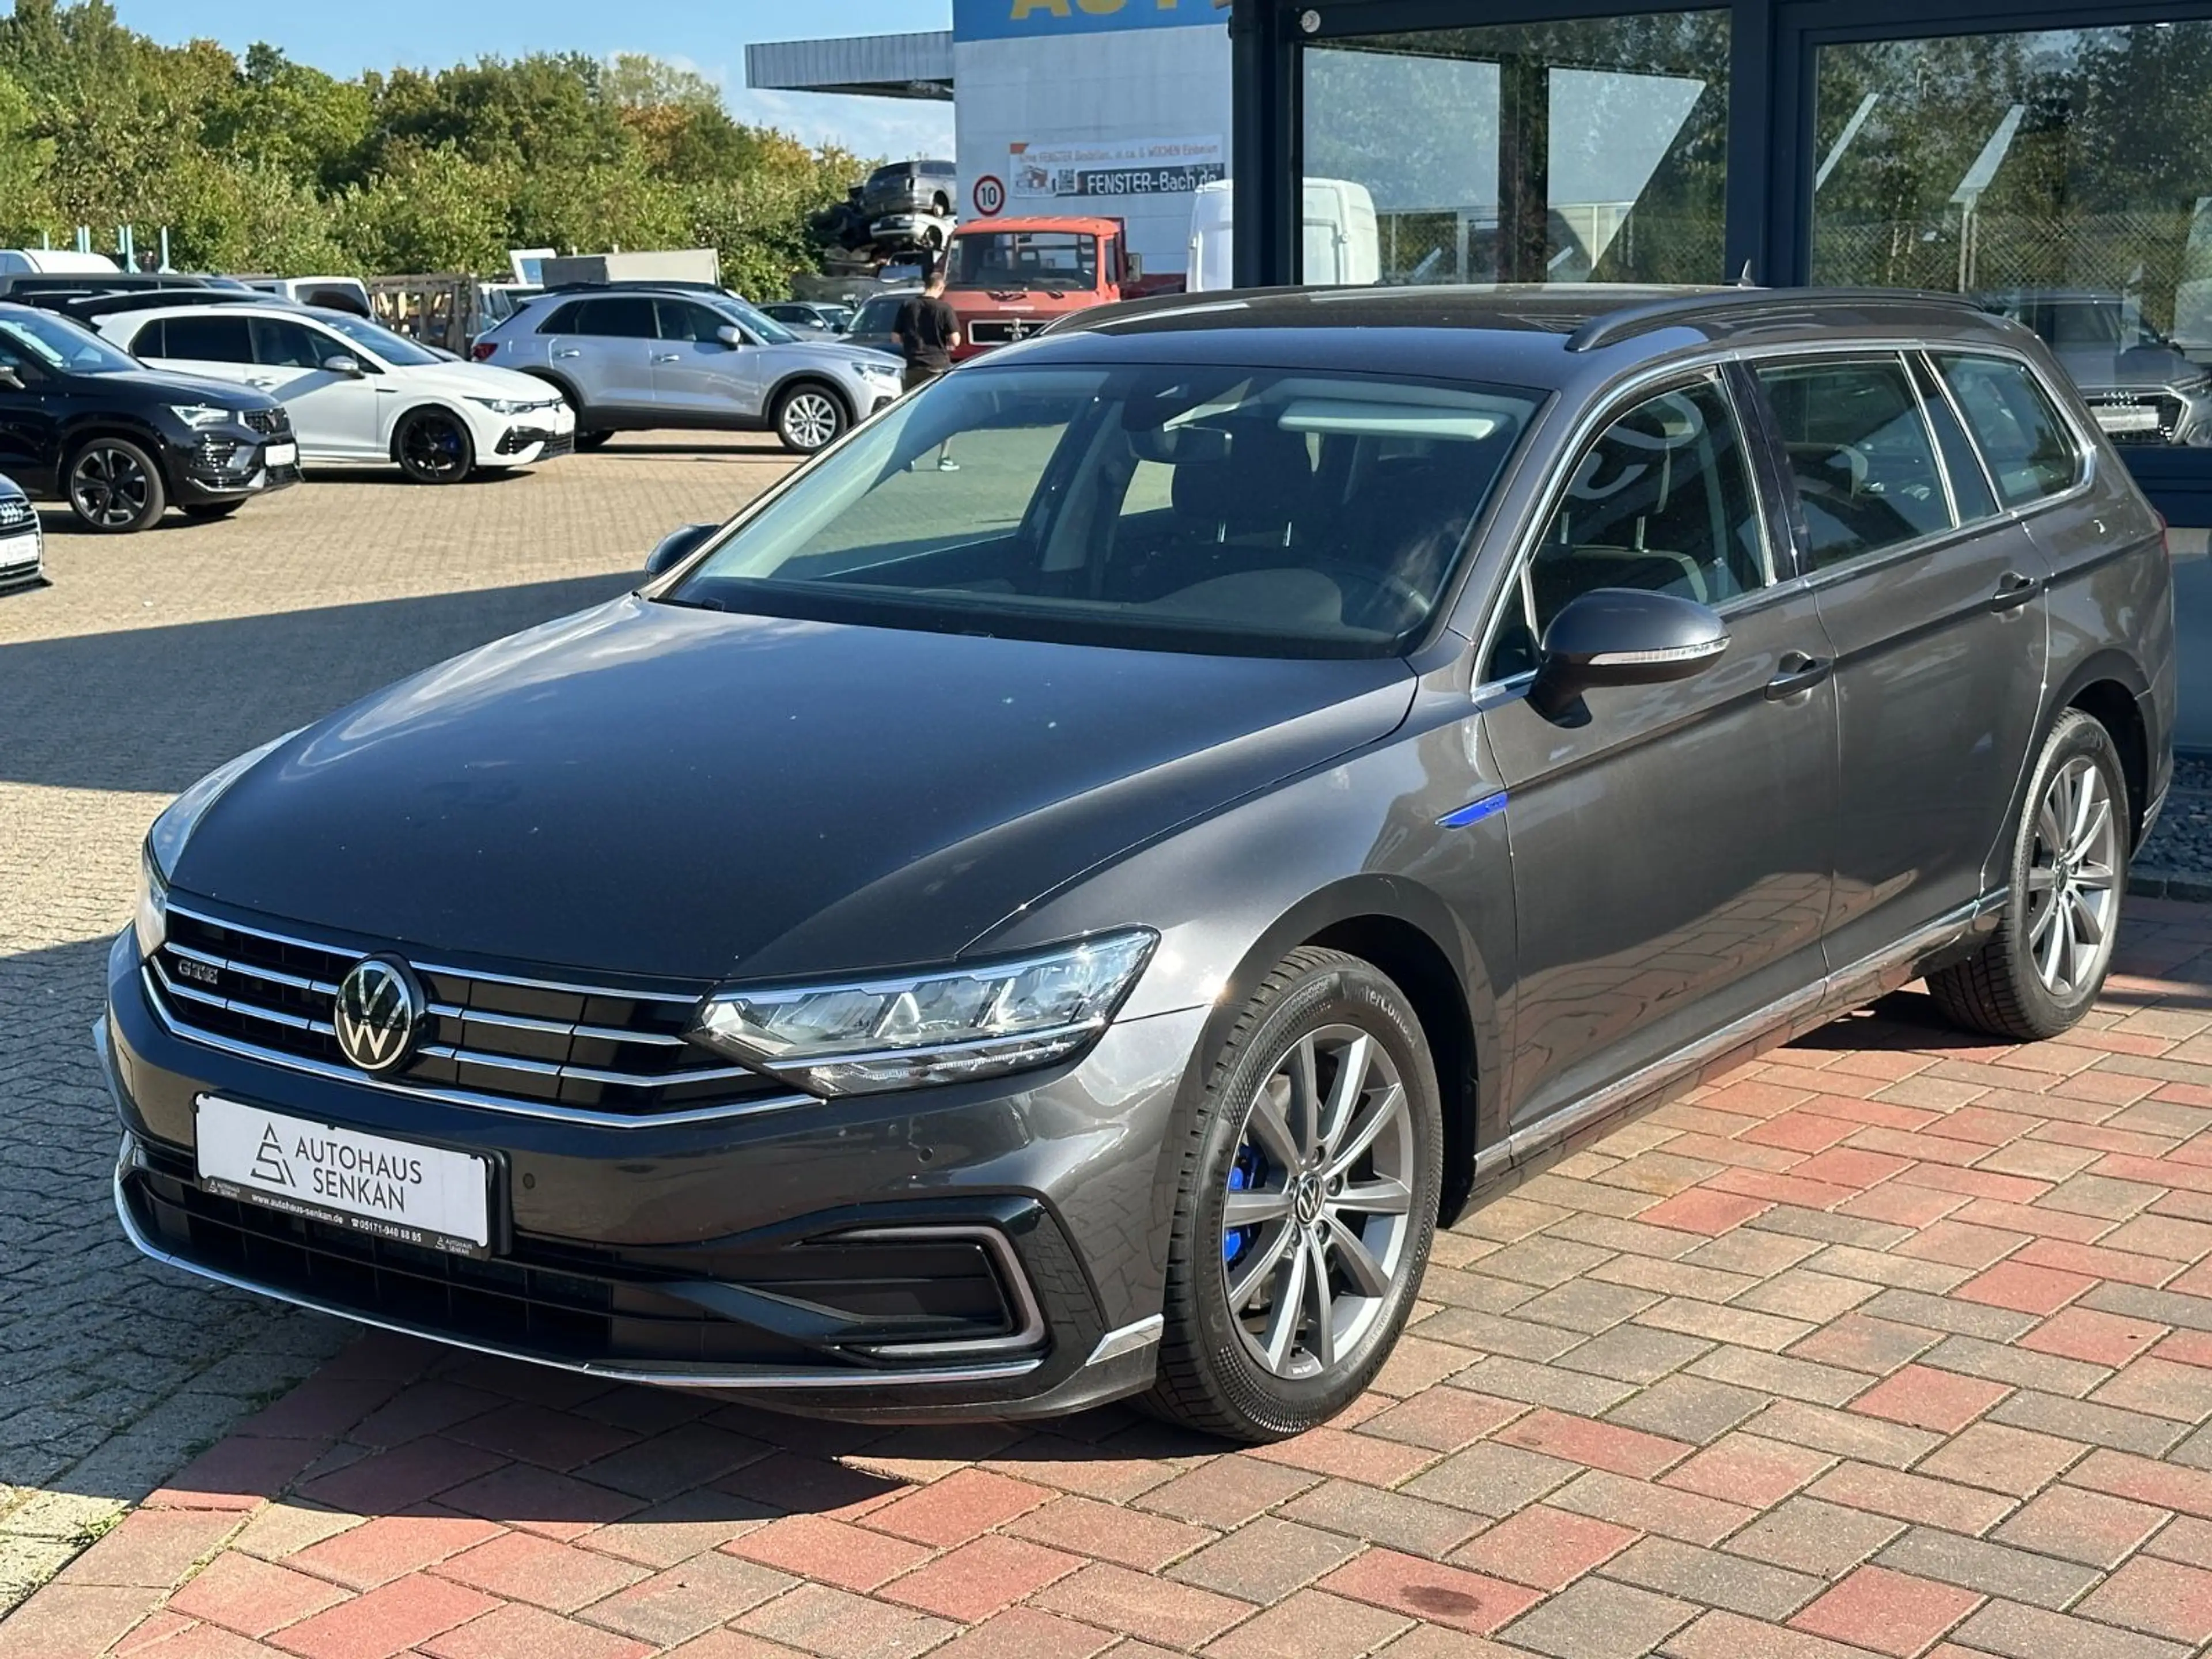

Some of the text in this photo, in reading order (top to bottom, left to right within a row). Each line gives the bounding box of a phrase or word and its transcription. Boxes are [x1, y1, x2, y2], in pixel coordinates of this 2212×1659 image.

[981, 186, 997, 206] 10
[1087, 169, 1217, 195] FENSTER-Bachd
[178, 959, 218, 985] GTE
[296, 1135, 422, 1184] AUTOHAUS
[313, 1167, 405, 1214] SENKAN
[251, 1194, 344, 1225] www.autohaus-senkan.de
